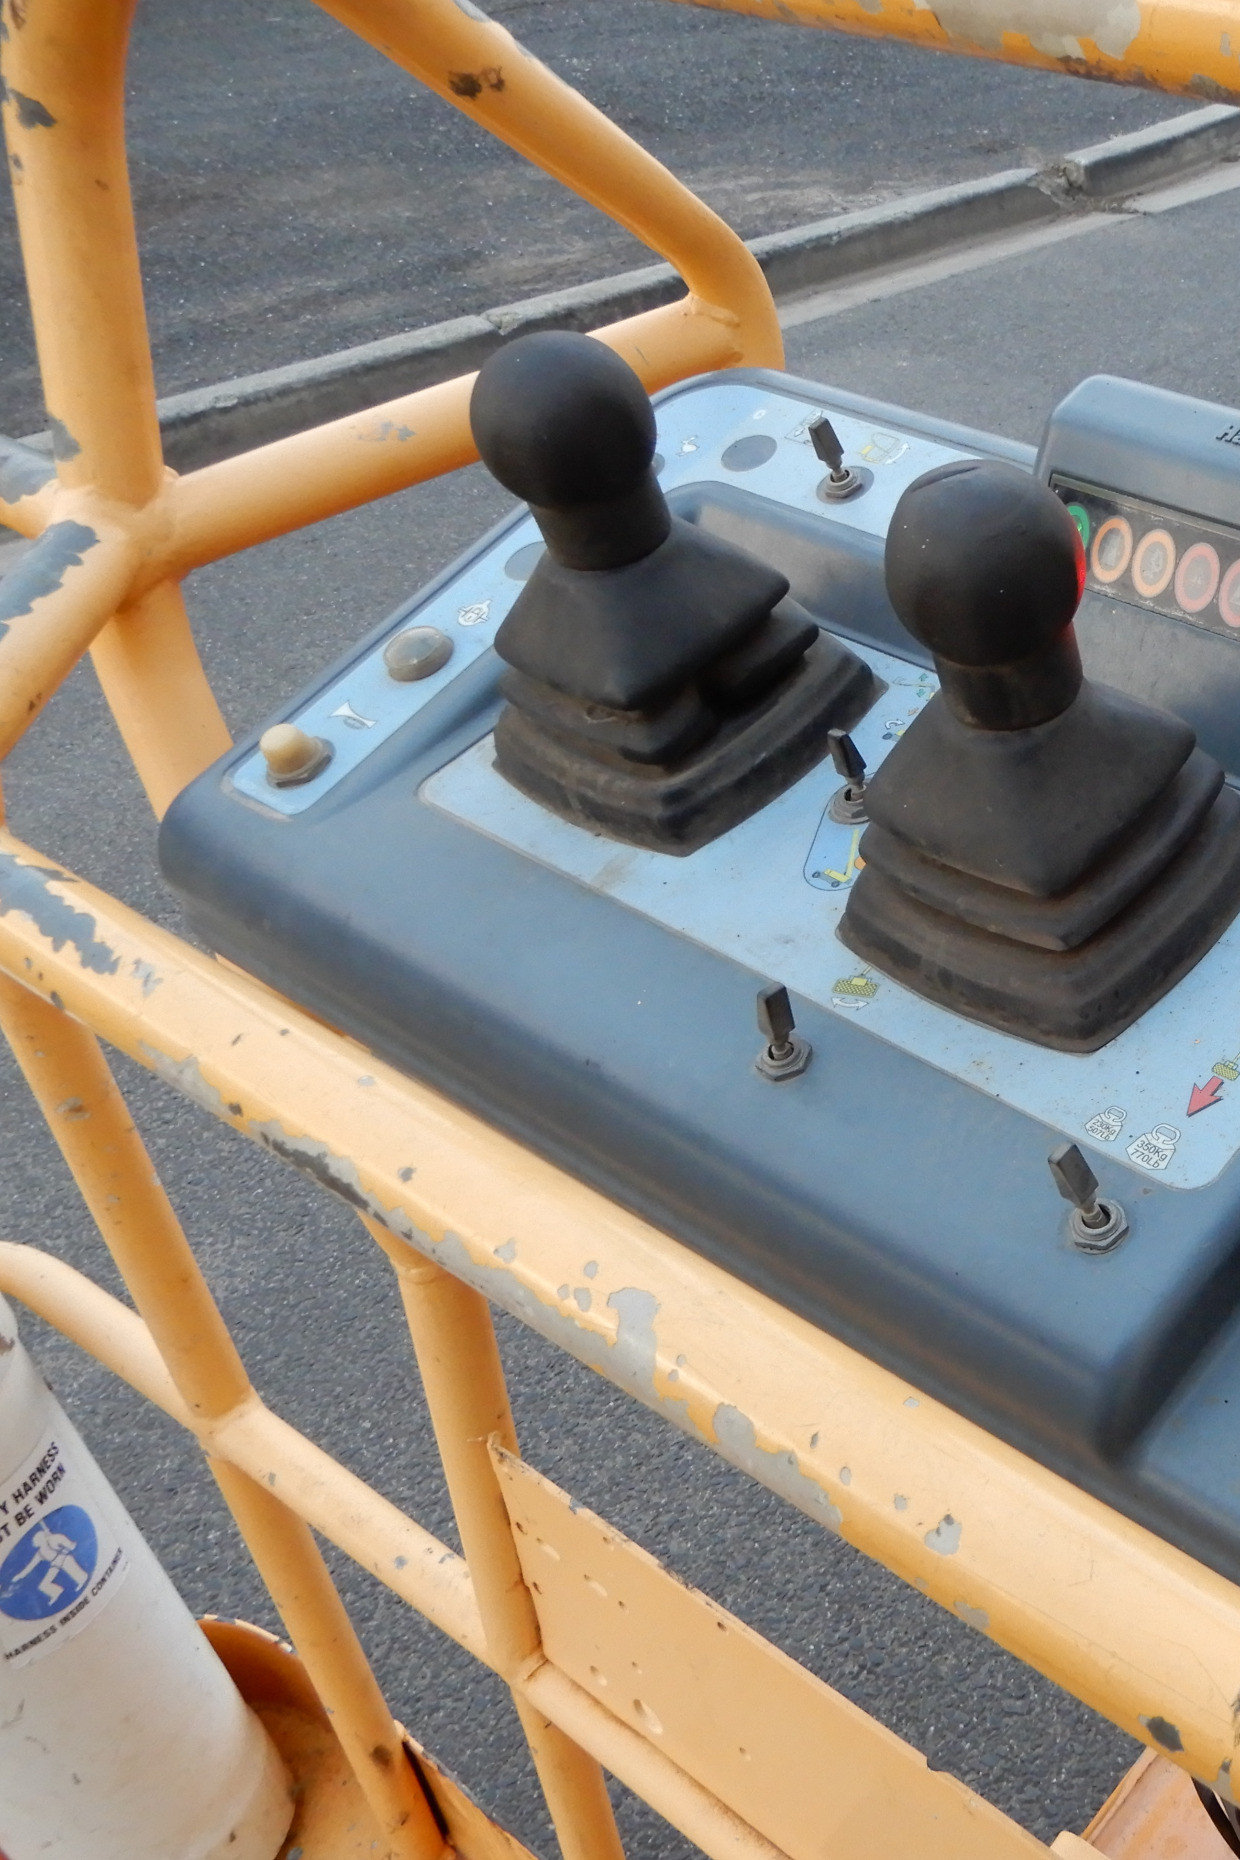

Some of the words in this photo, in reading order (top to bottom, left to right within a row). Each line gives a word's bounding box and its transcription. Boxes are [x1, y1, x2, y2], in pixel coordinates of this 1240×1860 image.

[1087, 1125, 1111, 1140] 507Lb
[1092, 1119, 1117, 1136] 230Kg
[1130, 1148, 1160, 1169] 770Lb
[1136, 1140, 1168, 1162] 350Kg
[12, 1441, 59, 1504] HARNESS
[14, 1503, 35, 1527] BE
[34, 1462, 66, 1506] WORN
[4, 1625, 57, 1660] HARNESS
[59, 1596, 90, 1626] INSIDE
